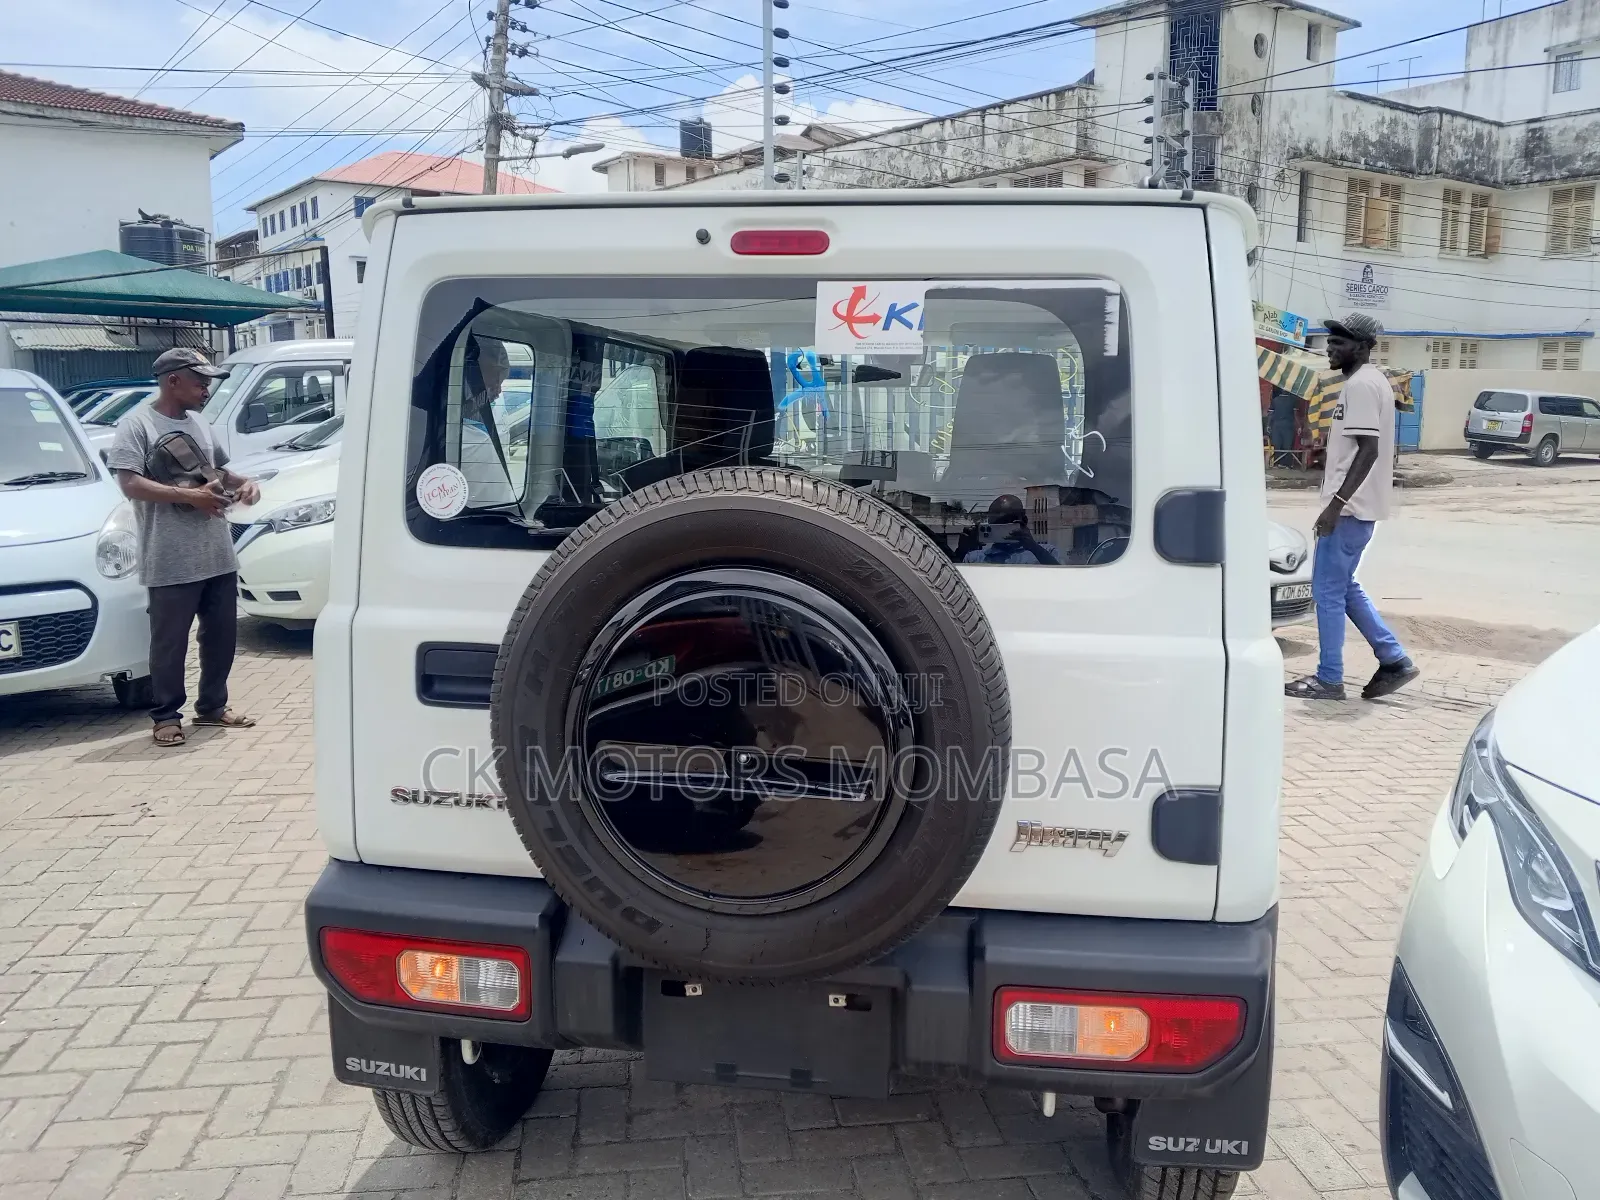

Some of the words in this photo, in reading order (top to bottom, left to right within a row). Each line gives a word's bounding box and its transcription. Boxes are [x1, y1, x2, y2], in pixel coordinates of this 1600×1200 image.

[1345, 283, 1367, 293] SERIES
[390, 785, 507, 813] SUZUKI
[345, 1056, 428, 1083] SUZUKI
[1147, 1134, 1250, 1157] SUZUKI
